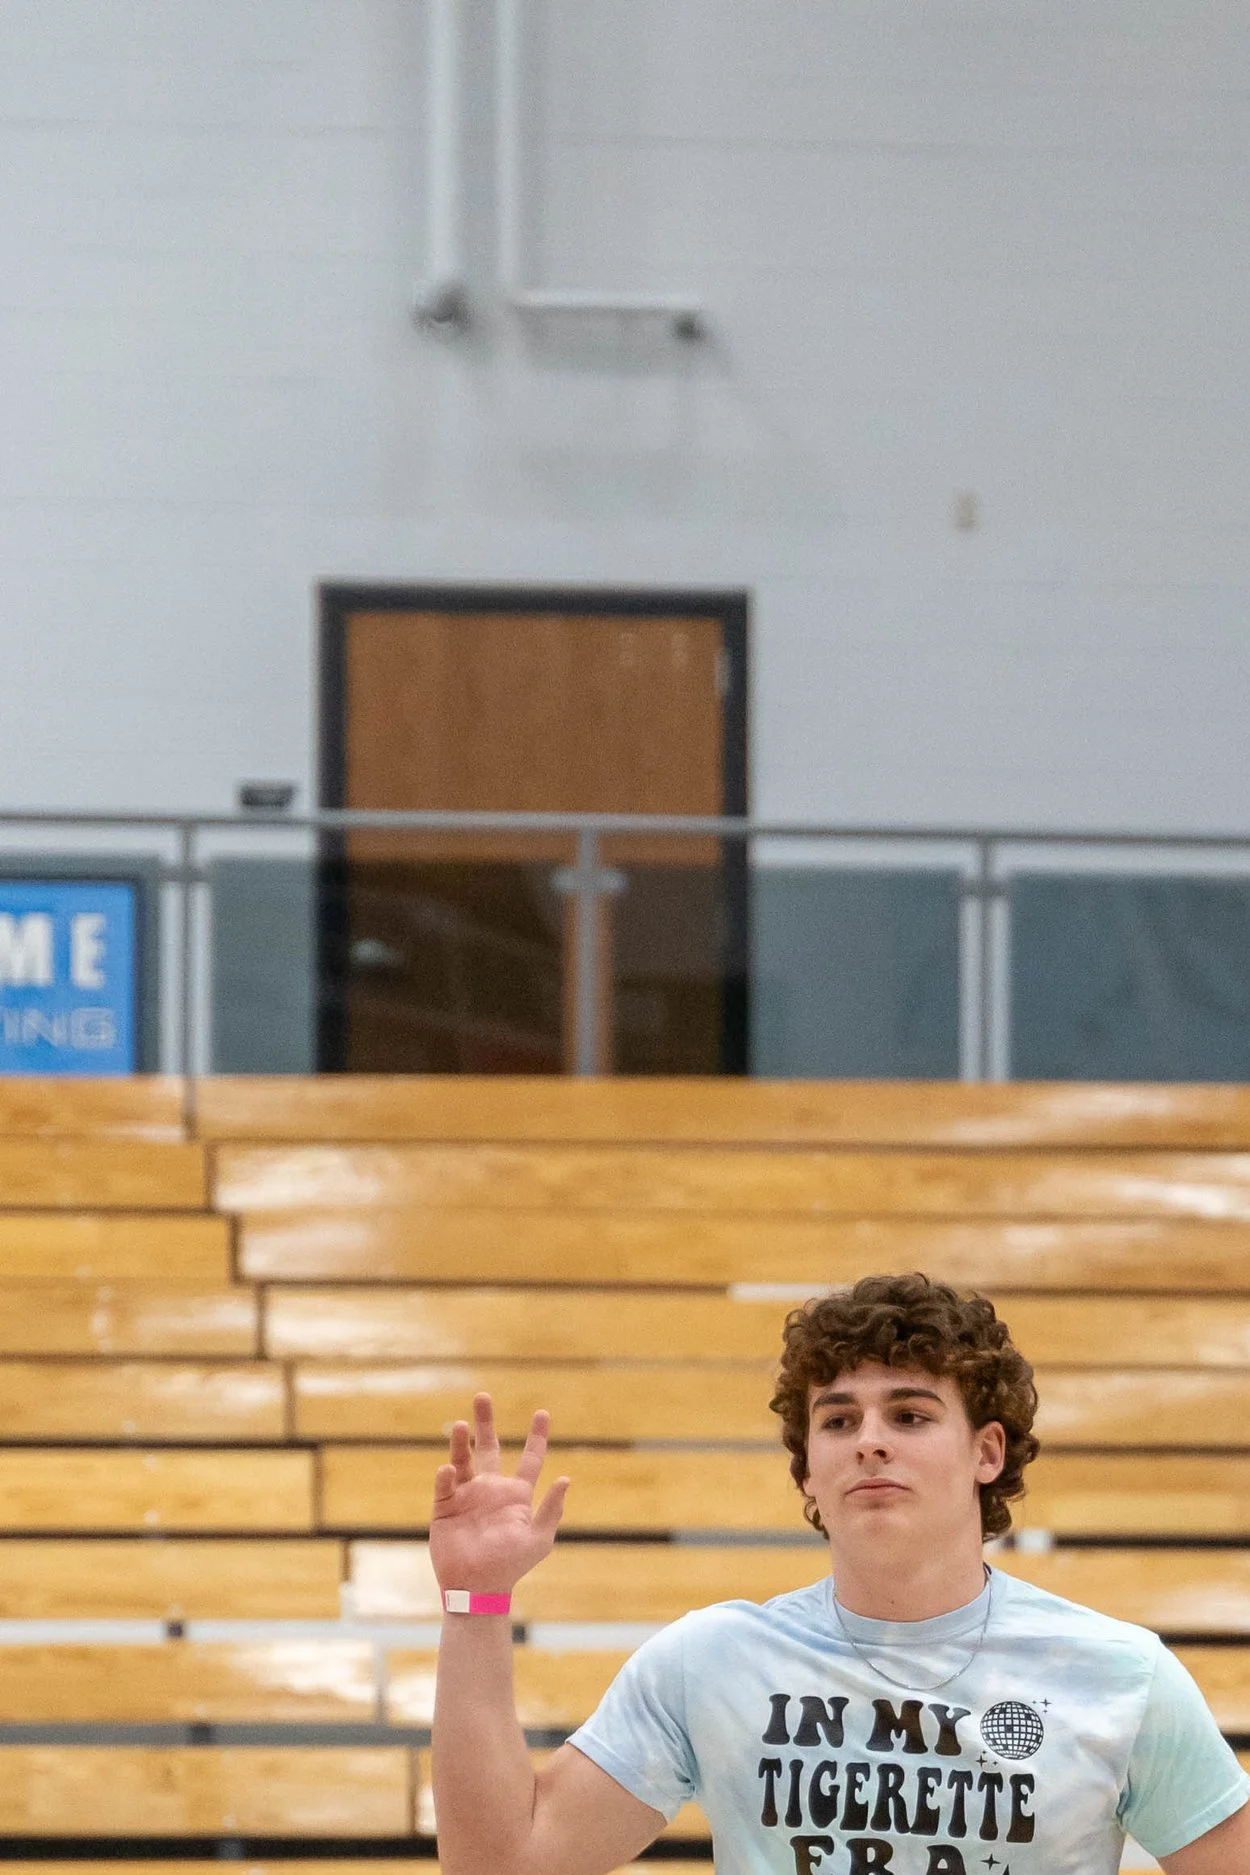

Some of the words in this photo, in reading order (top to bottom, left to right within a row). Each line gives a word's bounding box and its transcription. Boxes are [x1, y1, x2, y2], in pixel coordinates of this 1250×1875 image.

[0, 1006, 118, 1050] ING
[761, 1693, 850, 1749] IN
[865, 1698, 972, 1756] MY
[758, 1757, 1036, 1843] TIGERETTE
